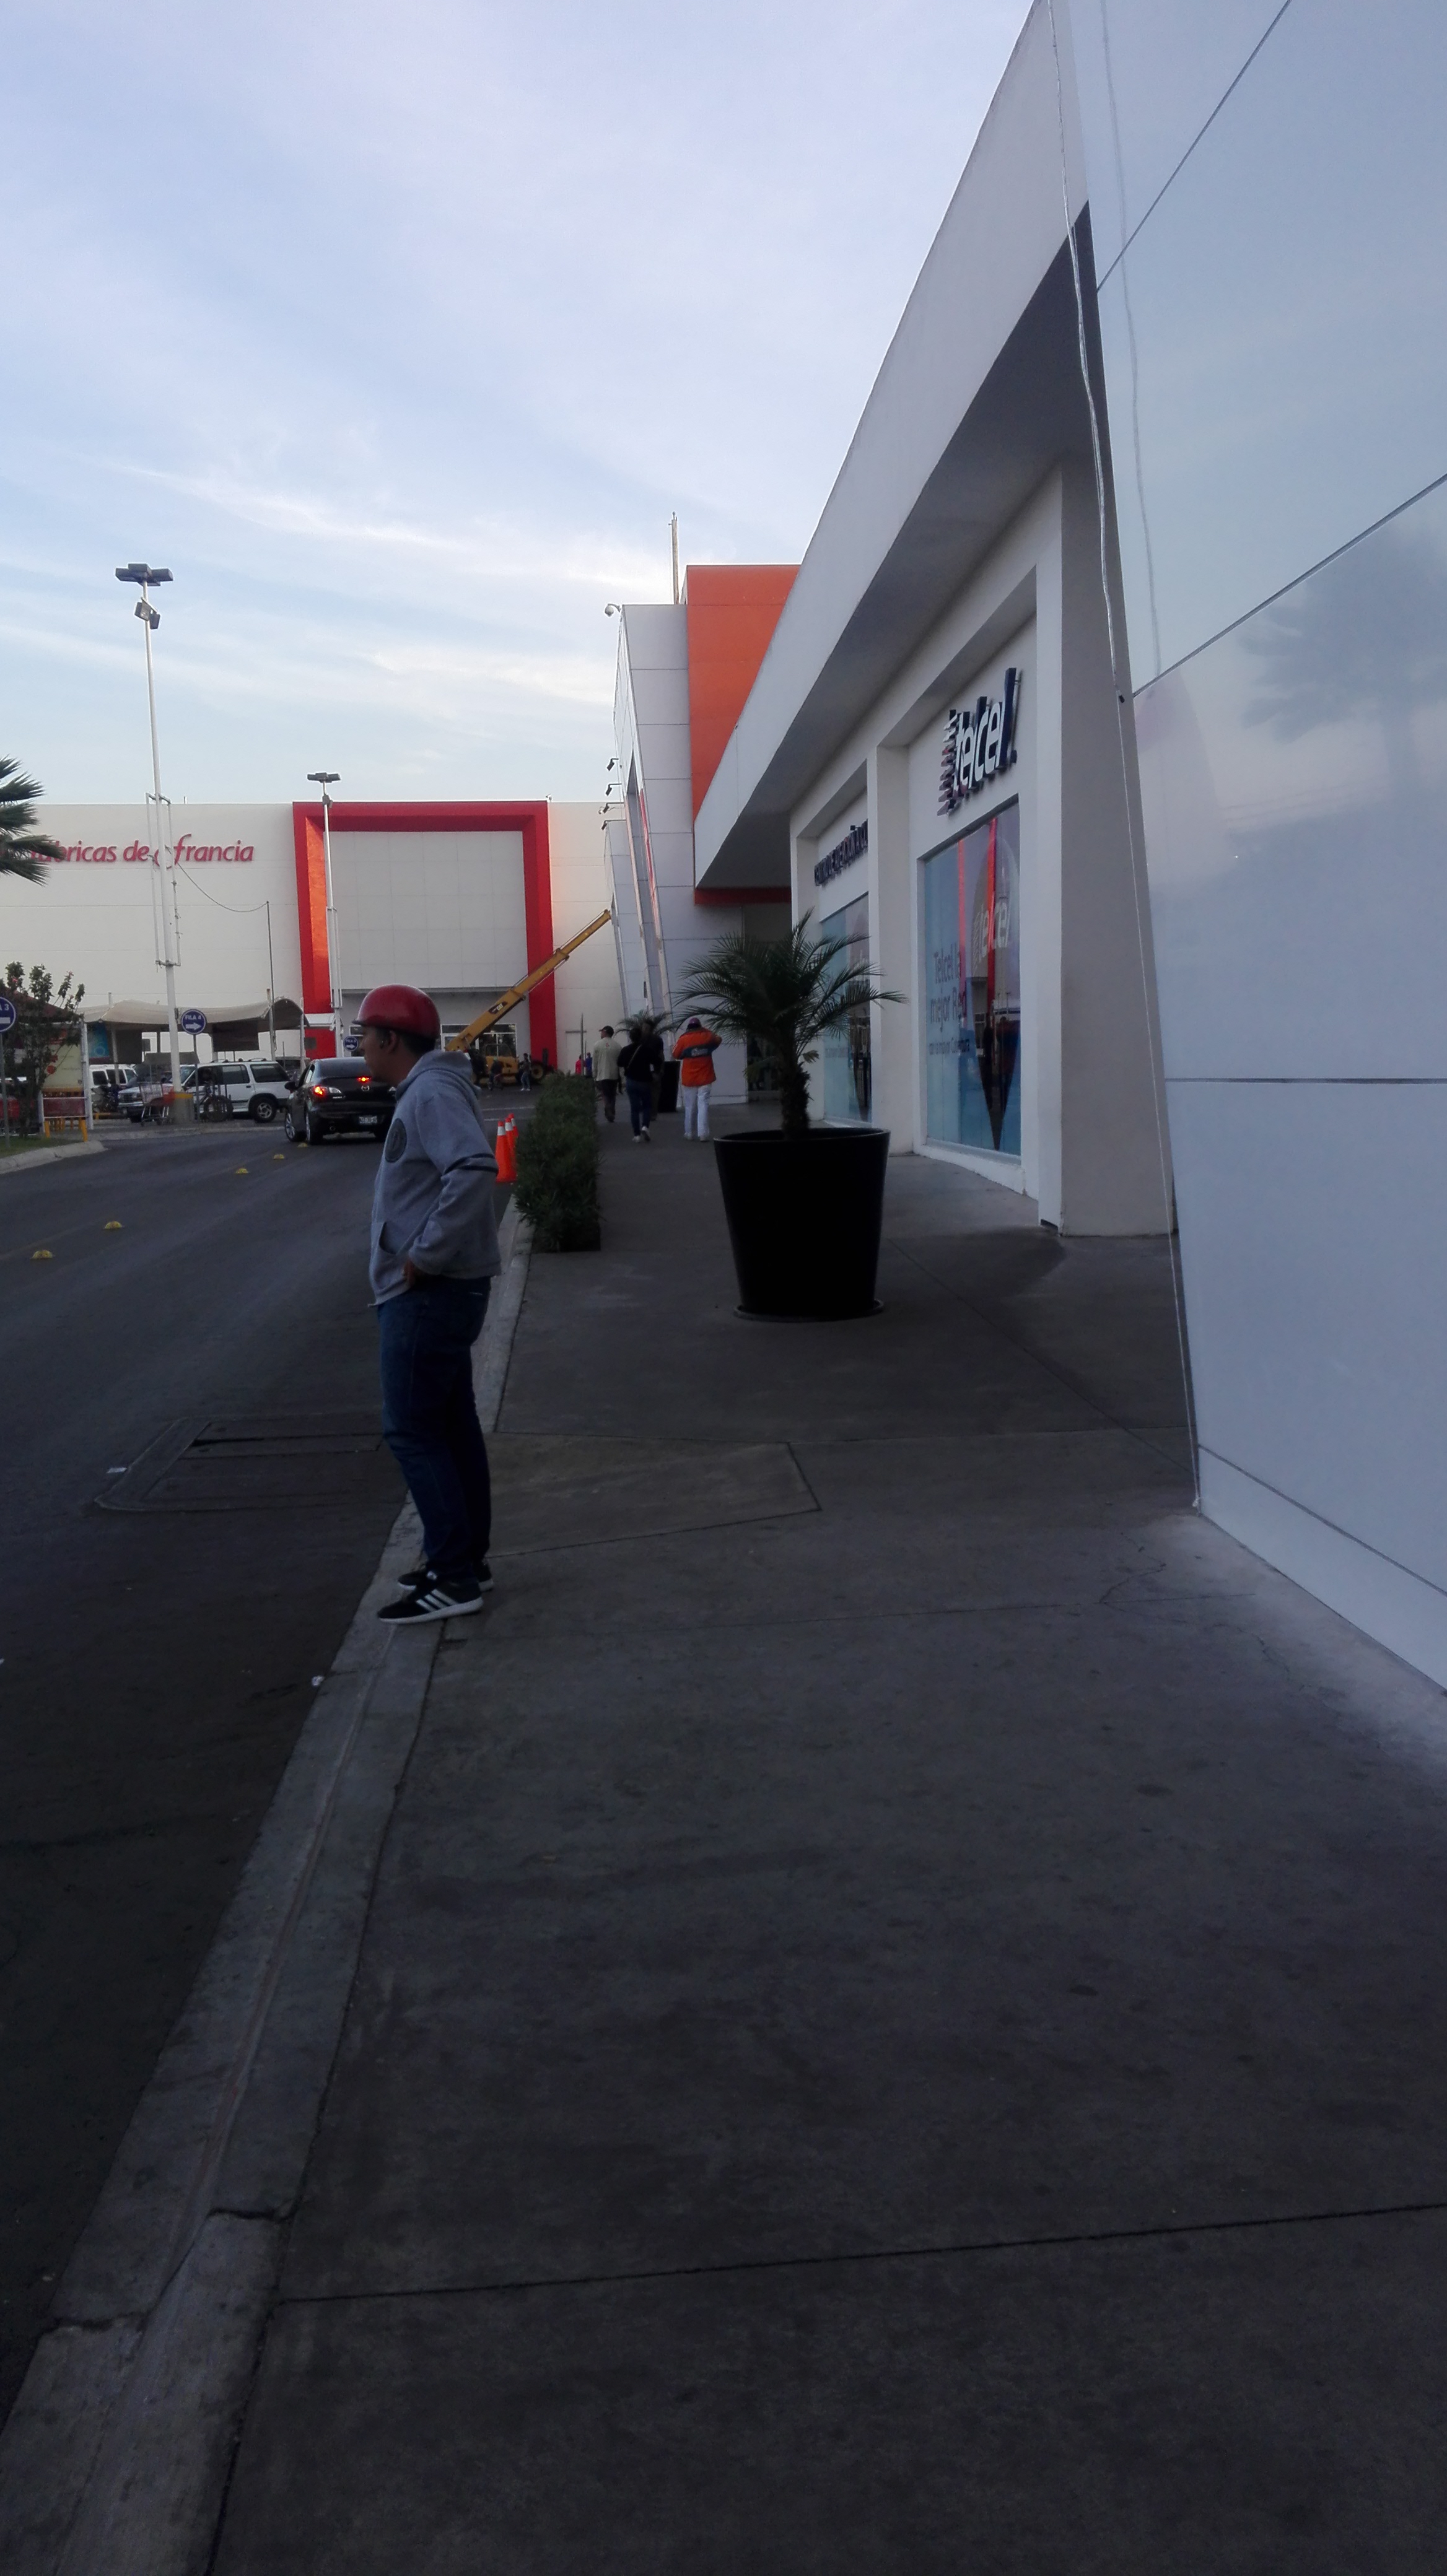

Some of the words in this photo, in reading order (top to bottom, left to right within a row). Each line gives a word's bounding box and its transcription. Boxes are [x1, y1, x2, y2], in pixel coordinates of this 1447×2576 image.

[951, 668, 1017, 798] telcel
[123, 840, 150, 862] de
[173, 833, 254, 866] francia
